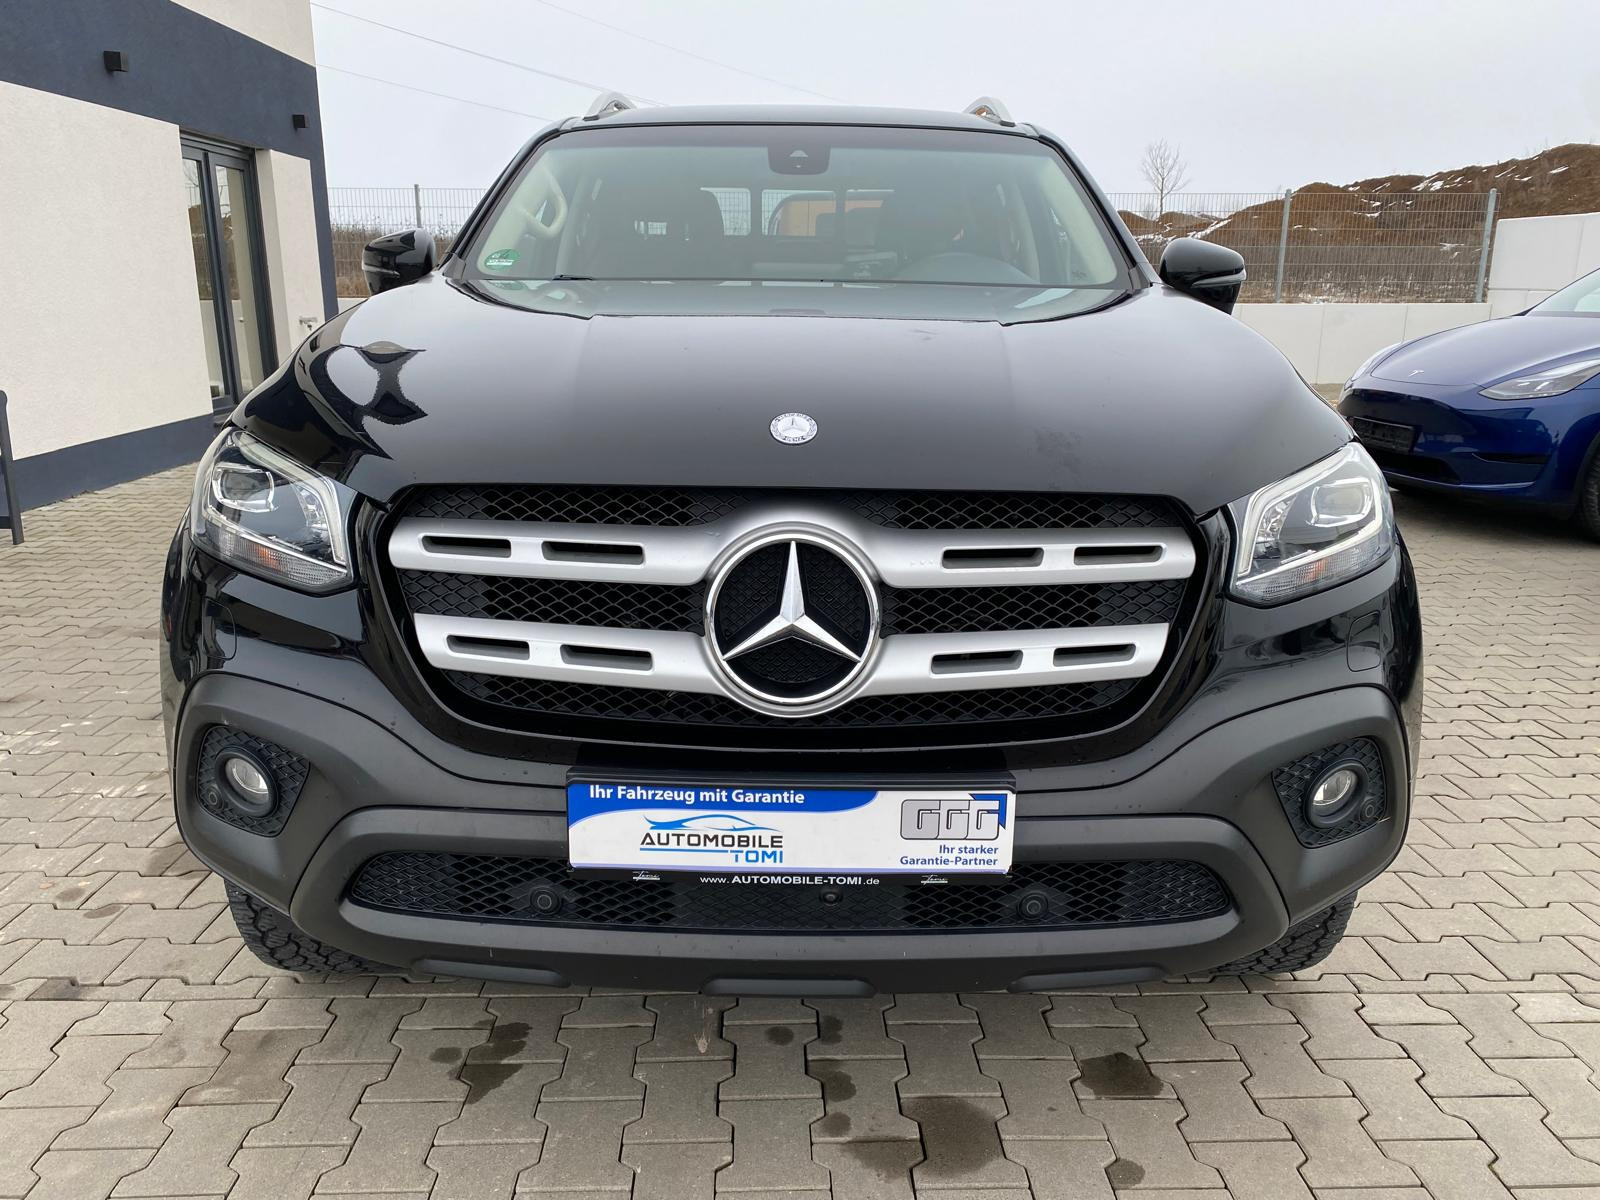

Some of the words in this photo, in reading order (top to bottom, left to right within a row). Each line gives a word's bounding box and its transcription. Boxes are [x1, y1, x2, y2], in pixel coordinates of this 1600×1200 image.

[589, 785, 613, 799] Ihr
[617, 786, 695, 805] Fahrzeug
[700, 789, 728, 802] mit
[731, 789, 805, 804] Garantie
[900, 799, 1000, 841] GGG
[640, 832, 784, 848] AUTOMOBILE
[729, 849, 784, 864] TOMI
[939, 844, 956, 854] Ihr
[958, 844, 999, 855] starker
[900, 855, 999, 866] Garantie-Partner
